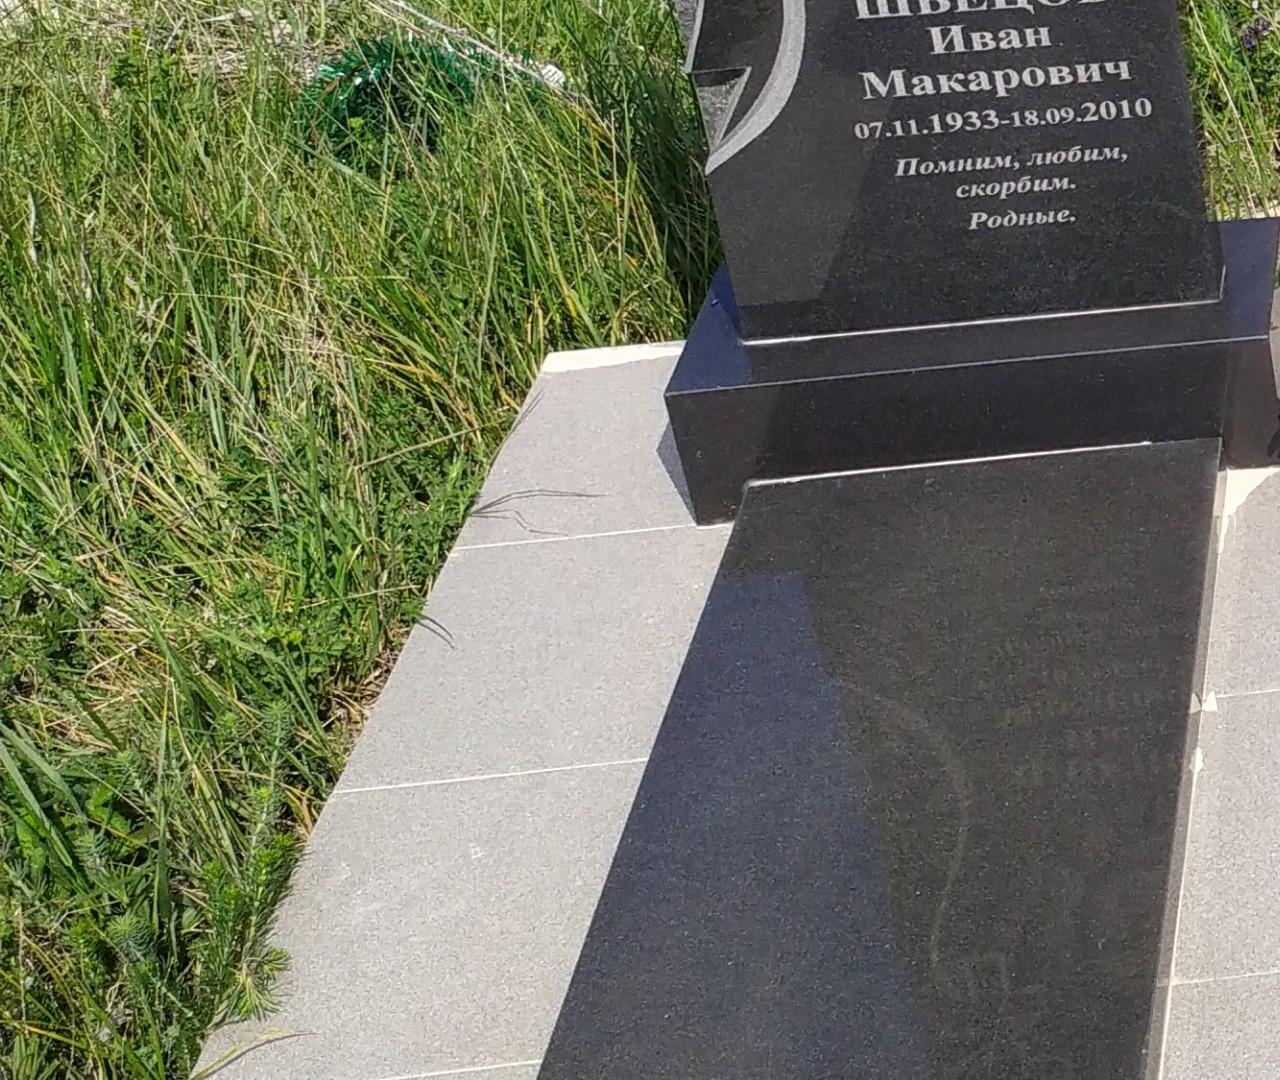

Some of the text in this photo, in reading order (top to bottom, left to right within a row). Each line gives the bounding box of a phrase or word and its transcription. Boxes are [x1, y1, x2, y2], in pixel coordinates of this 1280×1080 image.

[926, 24, 1052, 55] Иван
[859, 60, 1132, 100] Макарович
[854, 97, 1152, 140] 07.11.1933-18.09.2010
[895, 145, 1129, 177] Помним, любим,
[955, 176, 1077, 199] скорбим.
[968, 208, 1076, 230] Родные.
